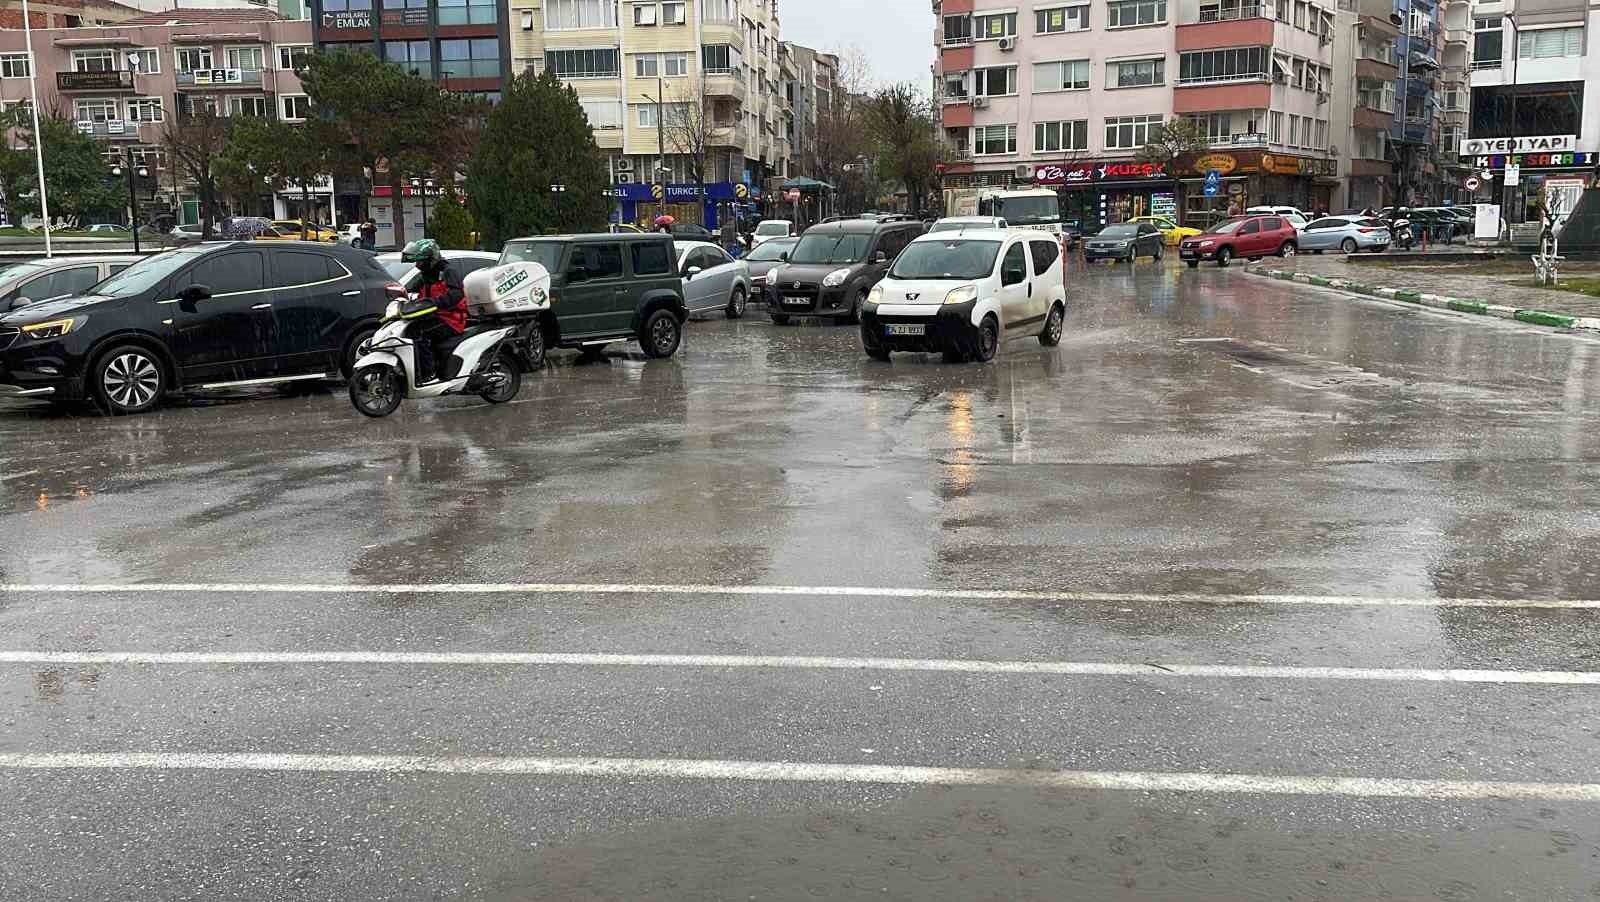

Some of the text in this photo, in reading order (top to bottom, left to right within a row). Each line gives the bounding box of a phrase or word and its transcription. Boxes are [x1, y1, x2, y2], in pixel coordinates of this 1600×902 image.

[337, 18, 371, 28] EMLAK
[1527, 137, 1568, 149] YAPI
[666, 187, 708, 195] TURKCEL
